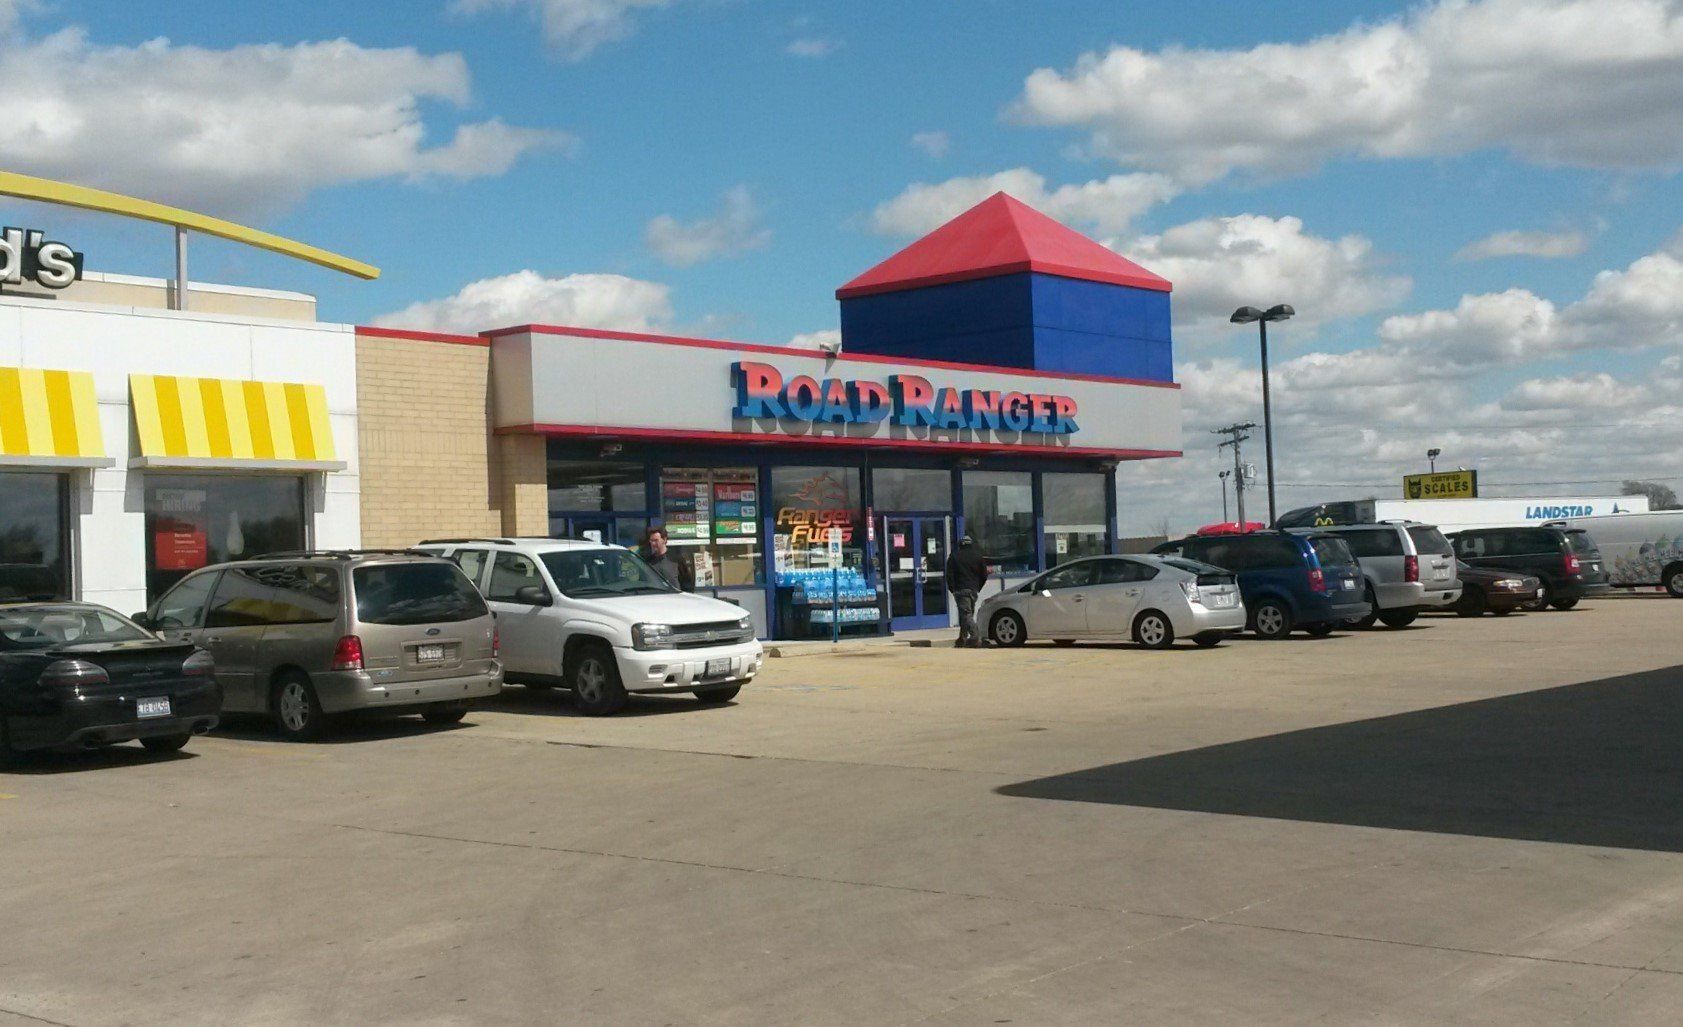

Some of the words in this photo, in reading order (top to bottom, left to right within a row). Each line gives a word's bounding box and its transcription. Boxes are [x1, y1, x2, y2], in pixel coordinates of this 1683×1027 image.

[733, 361, 892, 424] ROAD
[890, 373, 1080, 434] RANGER
[1424, 481, 1469, 494] SCALES
[1526, 506, 1593, 519] LANDSTAR
